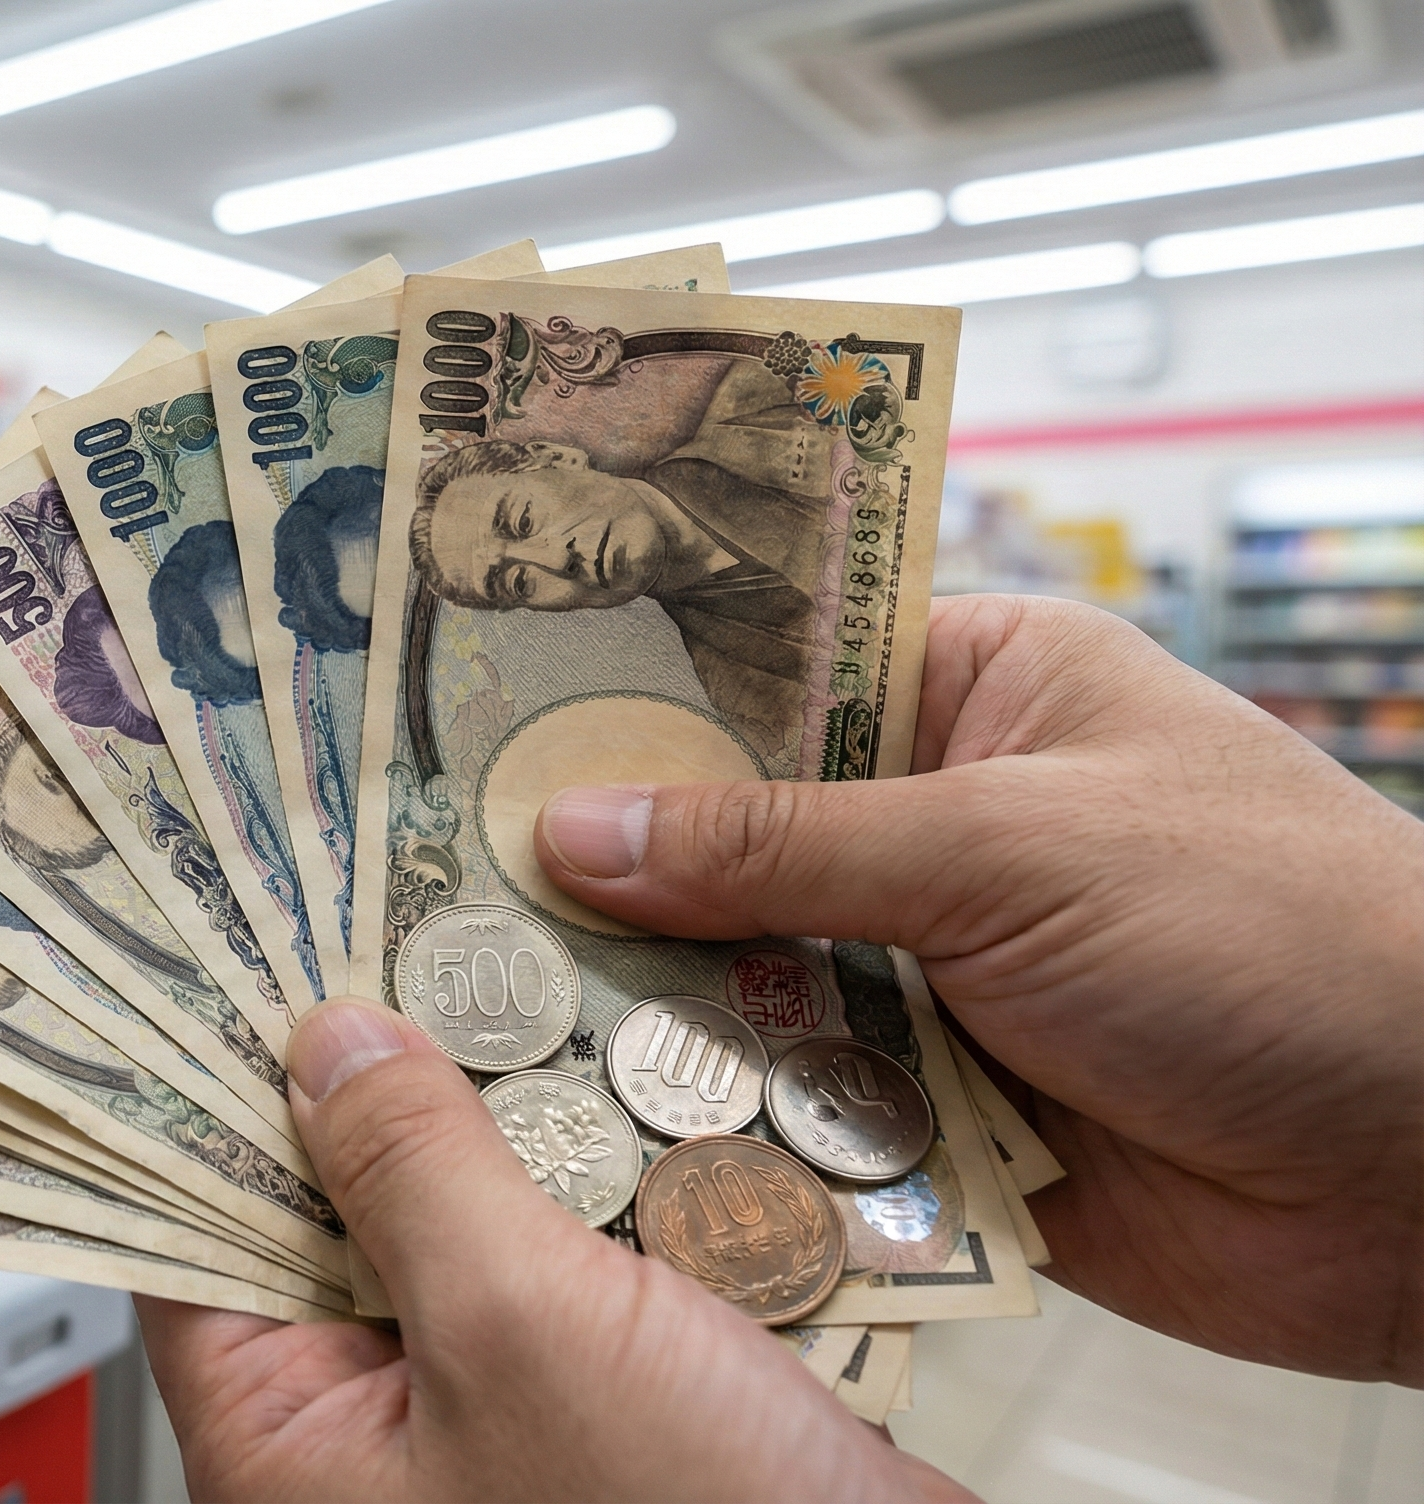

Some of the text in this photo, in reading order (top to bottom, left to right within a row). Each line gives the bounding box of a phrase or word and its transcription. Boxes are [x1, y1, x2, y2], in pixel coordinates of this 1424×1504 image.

[237, 345, 313, 470] 1000
[419, 310, 497, 438] 1000
[74, 417, 169, 544] 1000
[433, 947, 547, 1018] 500
[631, 1010, 746, 1104] 100
[682, 1159, 764, 1236] 10
